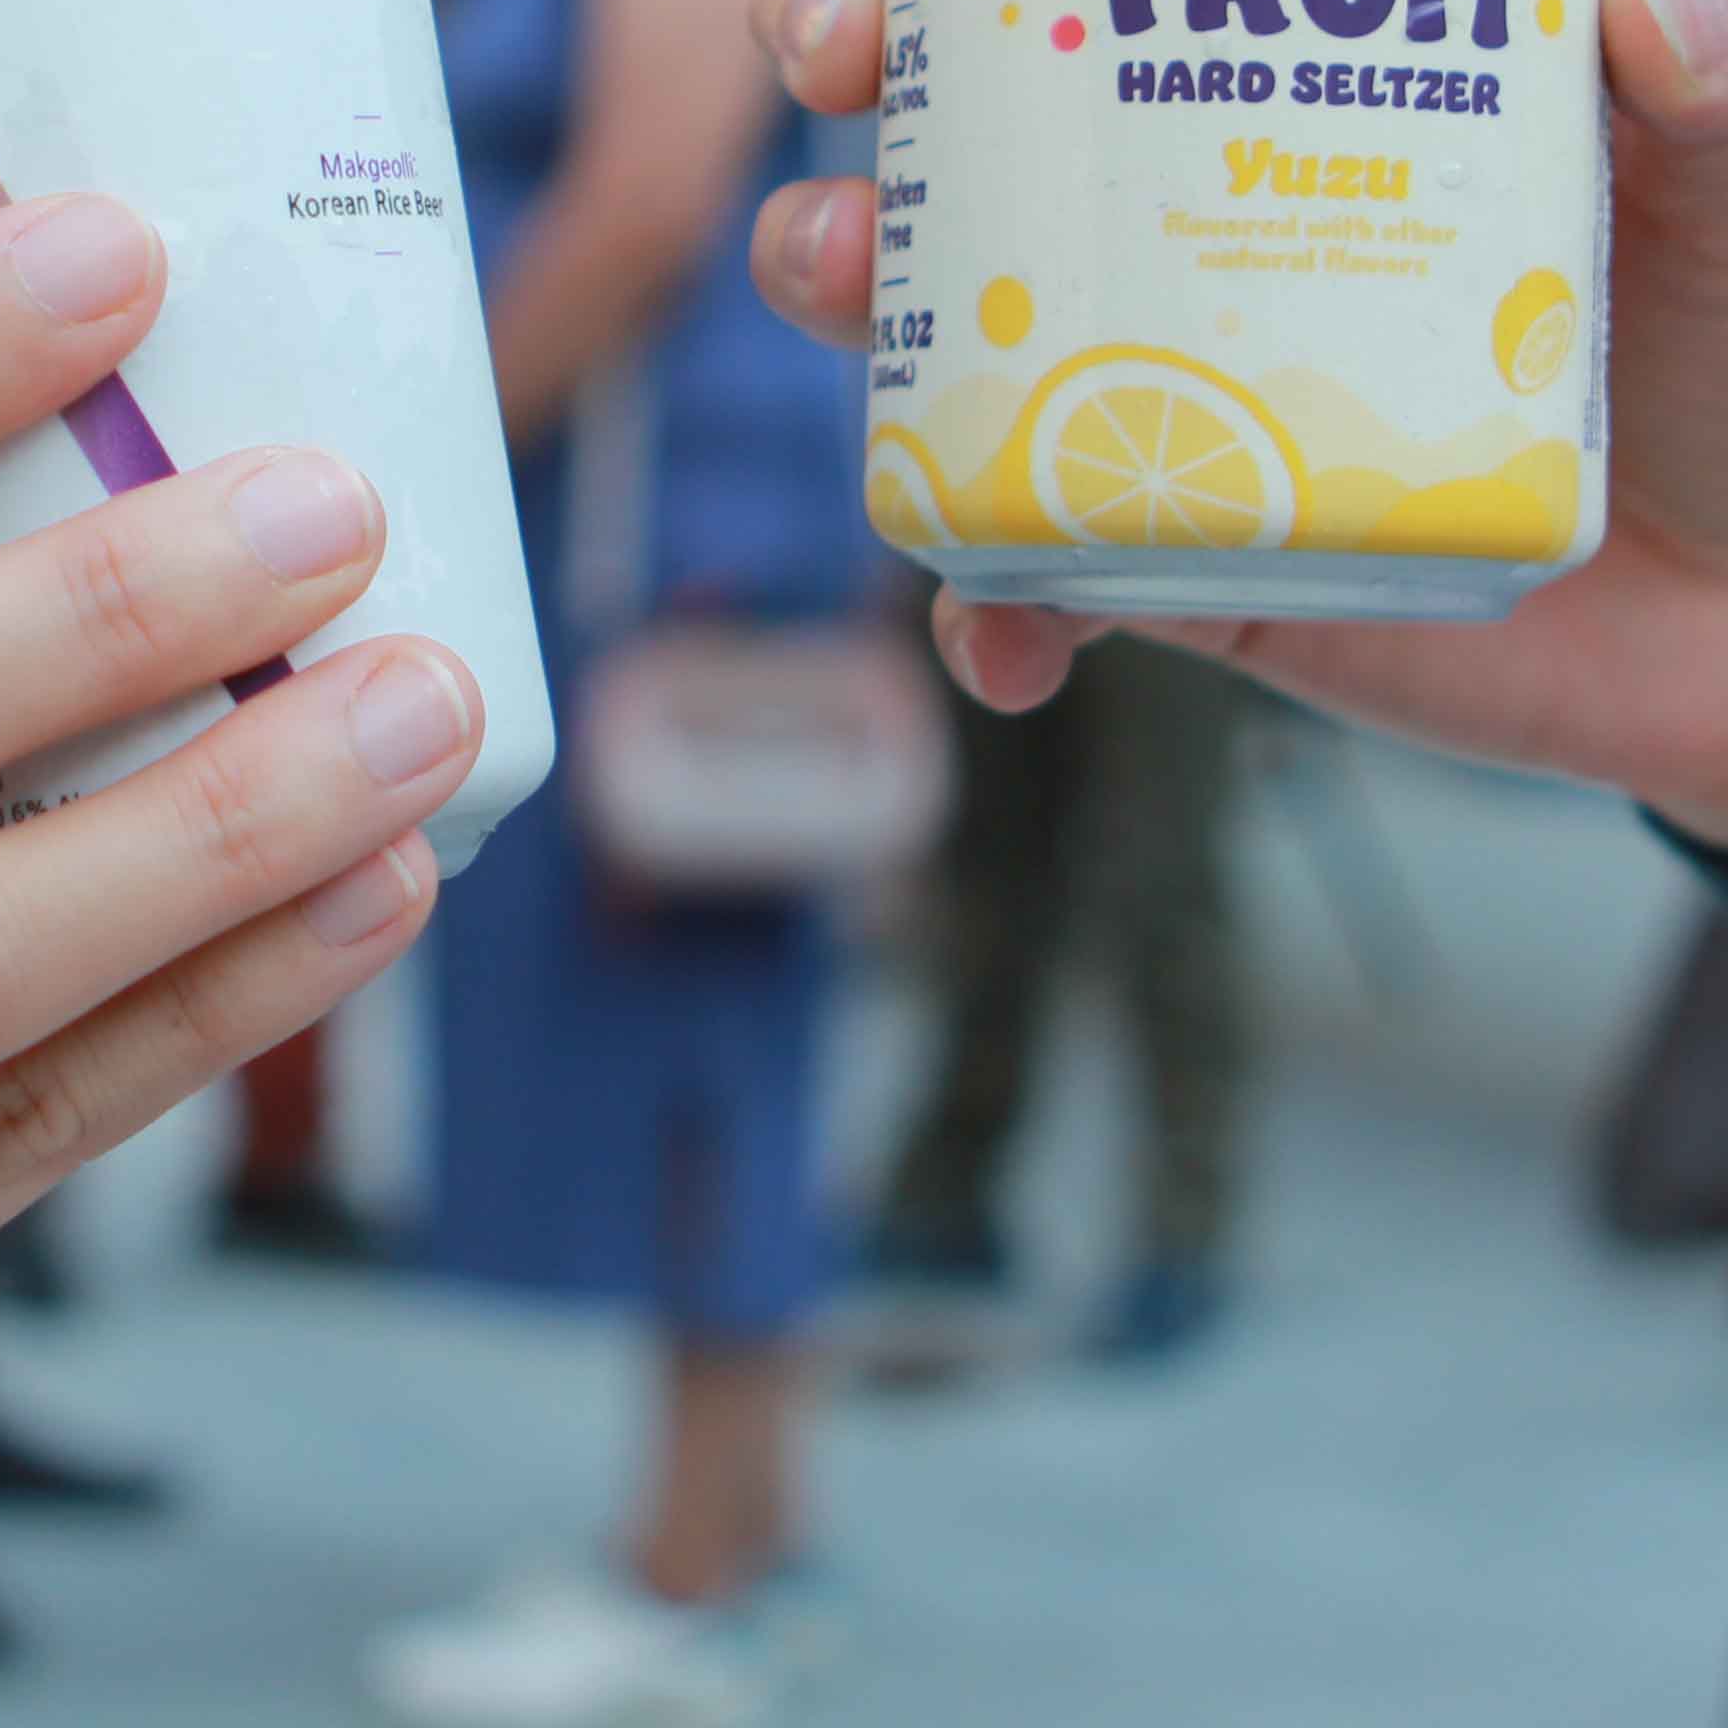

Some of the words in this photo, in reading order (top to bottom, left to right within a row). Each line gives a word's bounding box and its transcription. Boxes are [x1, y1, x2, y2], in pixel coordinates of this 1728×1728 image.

[1117, 59, 1276, 104] HARD
[1289, 61, 1501, 116] SELTZER
[1223, 137, 1411, 201] Yuzu
[287, 191, 370, 220] Korean
[374, 189, 412, 216] Rice
[414, 189, 445, 218] Beer
[1304, 215, 1376, 241] with
[1381, 217, 1458, 245] other
[901, 308, 934, 350] OZ
